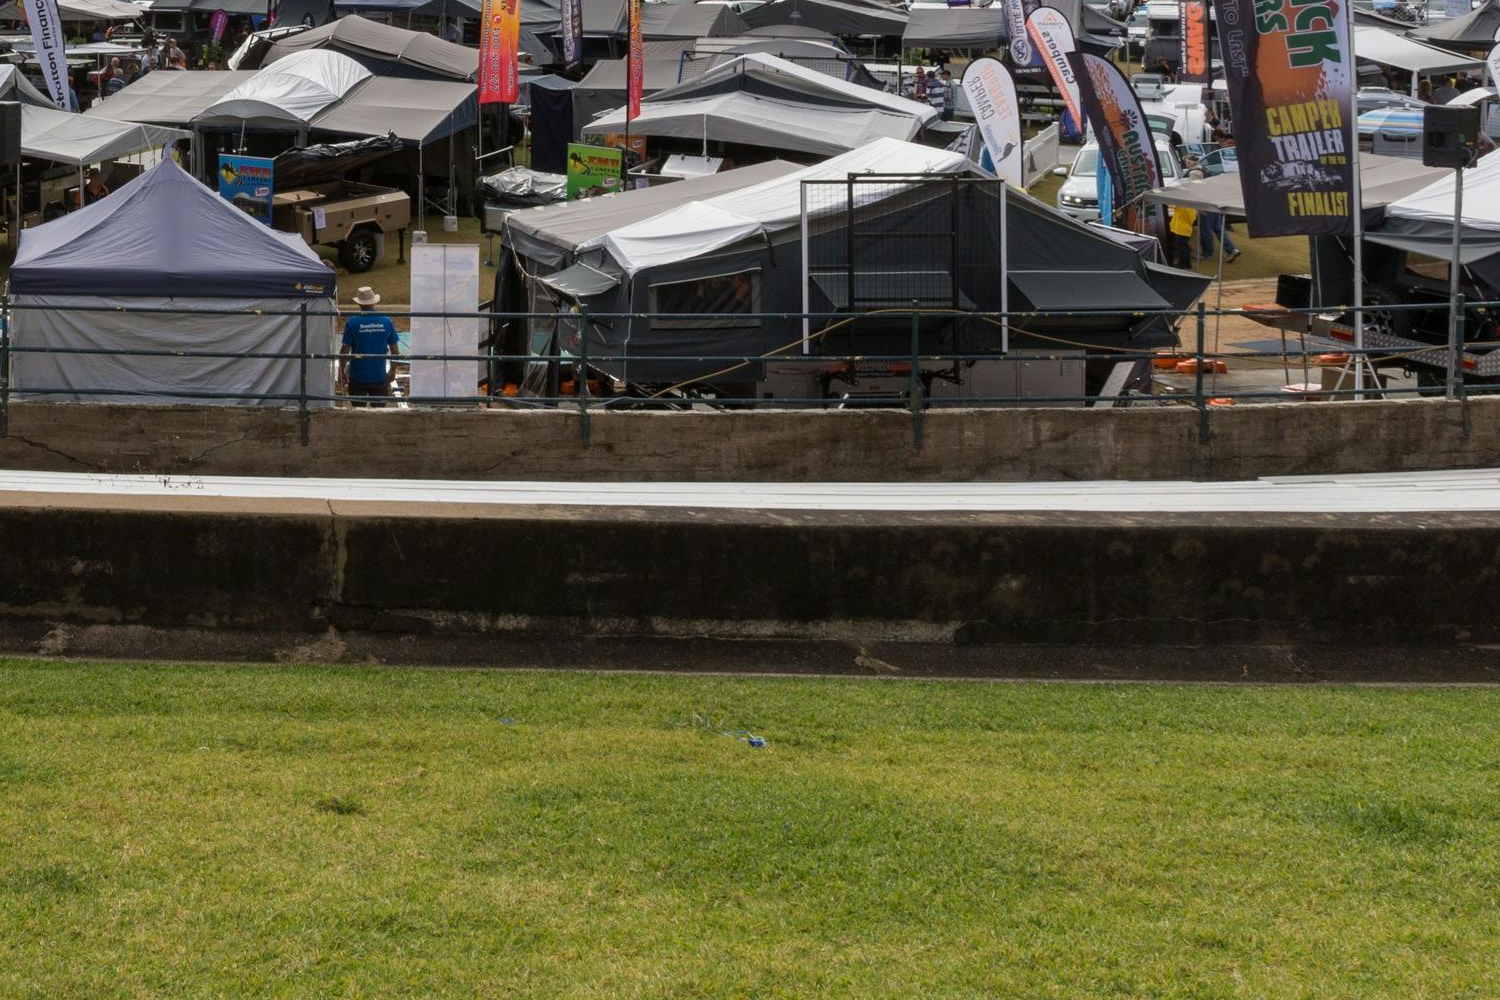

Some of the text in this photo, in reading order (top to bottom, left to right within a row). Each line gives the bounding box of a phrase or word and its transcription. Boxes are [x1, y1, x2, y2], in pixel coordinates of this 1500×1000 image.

[1266, 100, 1342, 136] CAMPER
[1270, 129, 1345, 163] TRAILER
[1287, 192, 1349, 217] FINALIST
